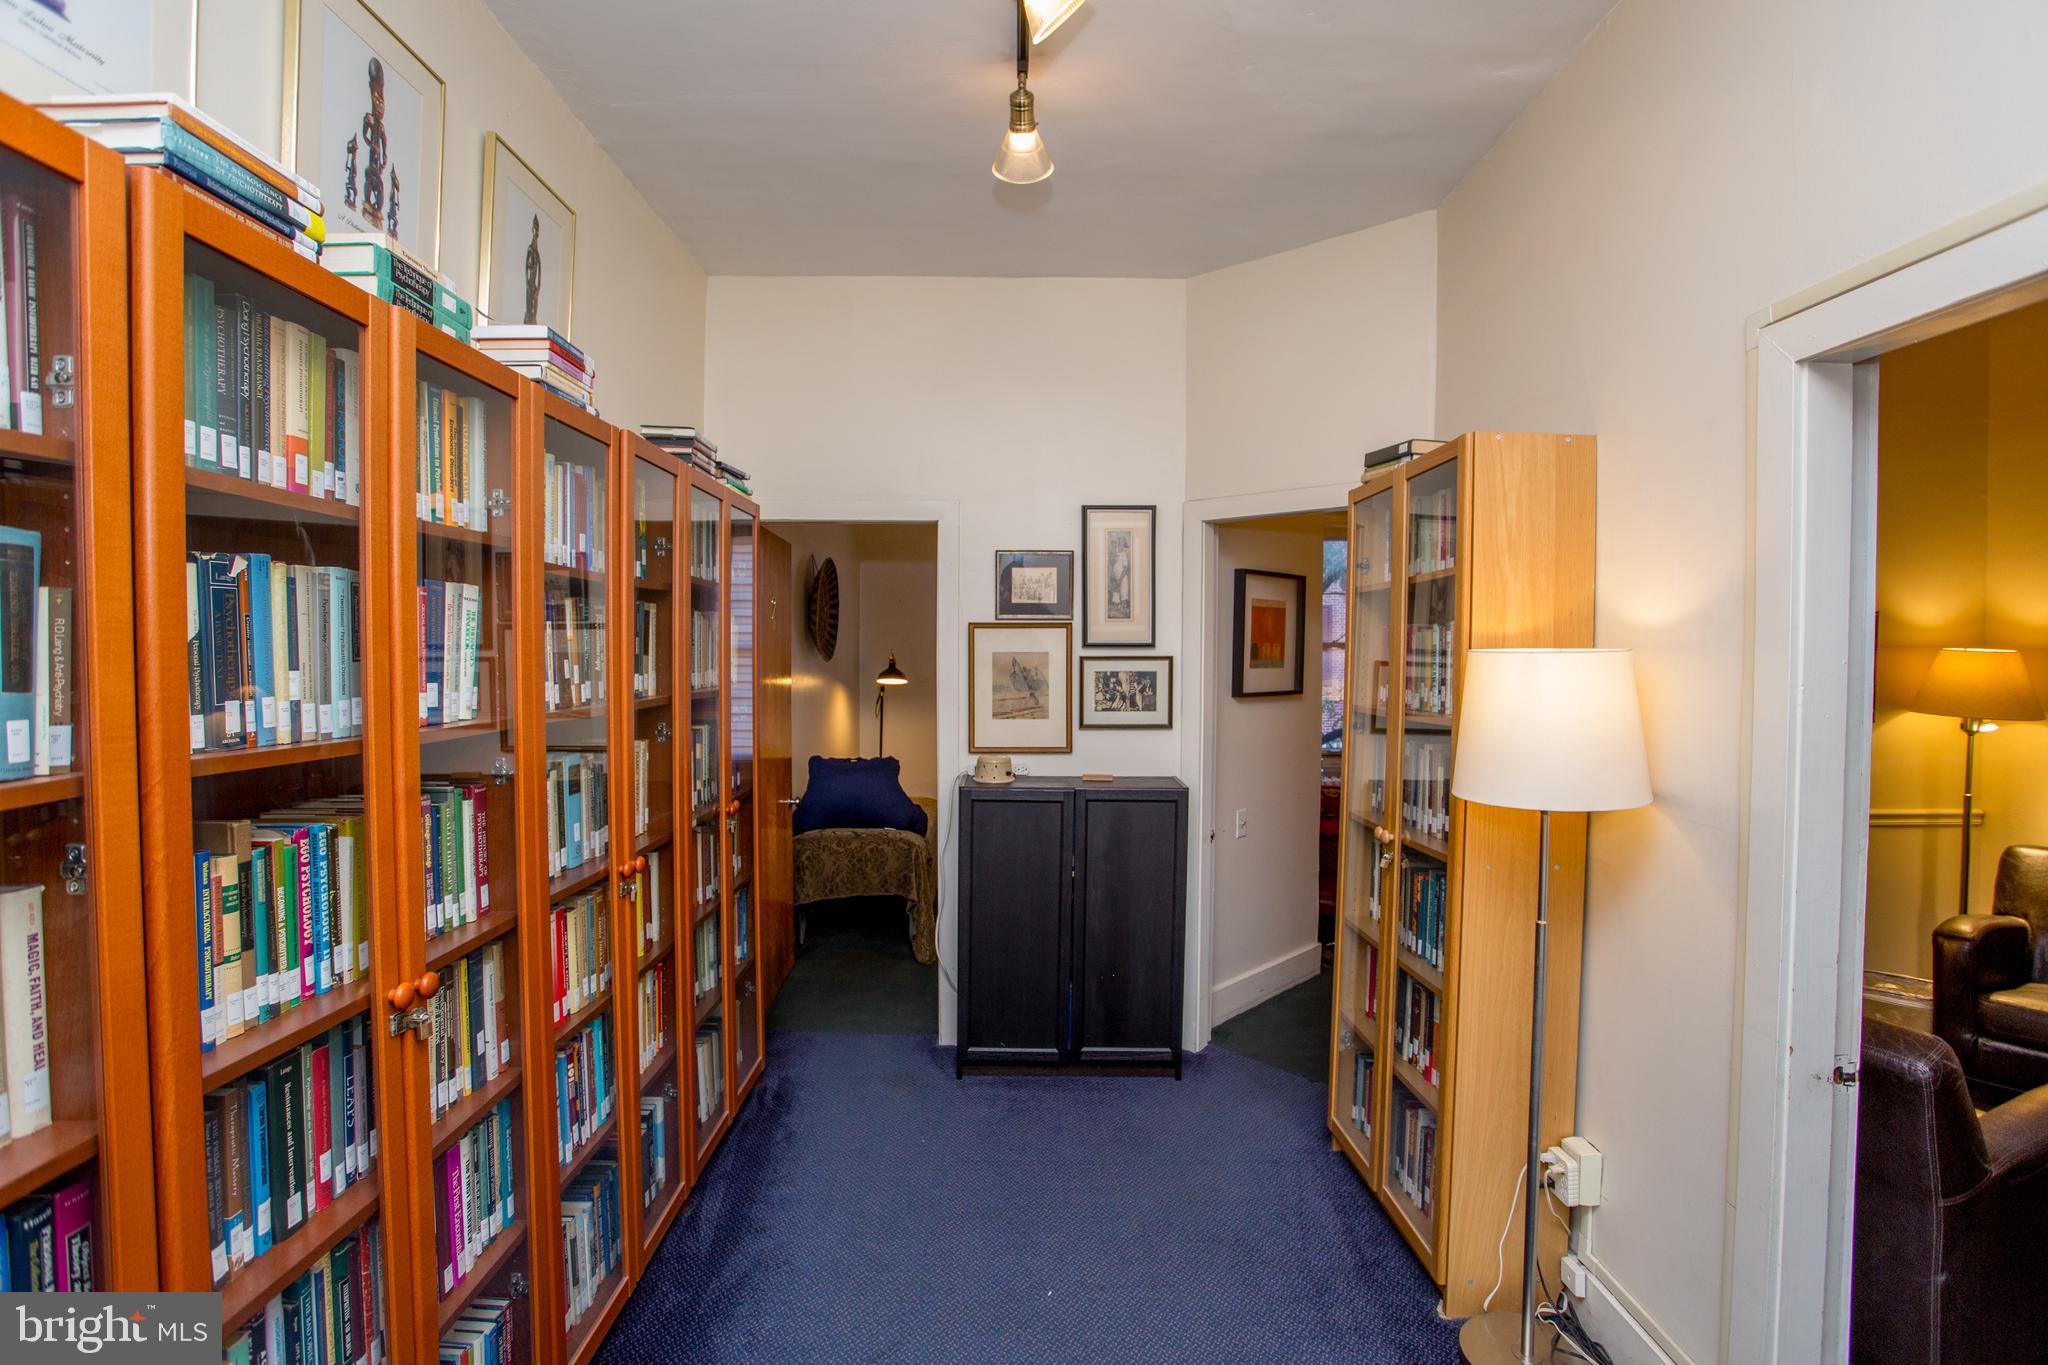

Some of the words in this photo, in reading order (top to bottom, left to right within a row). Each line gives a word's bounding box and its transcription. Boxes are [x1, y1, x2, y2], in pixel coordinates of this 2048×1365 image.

[215, 165, 225, 177] OF
[227, 172, 285, 212] PSYCHOTHERAPY
[231, 166, 284, 203] NEUROSCIENCE
[263, 209, 290, 236] Psychotherapy
[392, 258, 404, 271] The
[401, 262, 426, 287] Technique
[395, 268, 431, 299] Psychotherapy
[216, 306, 227, 396] PSYCHOTHERAPY
[240, 331, 251, 400] Psychotherapy
[215, 620, 223, 645] BASIC
[223, 592, 240, 697] Psychotherapy
[216, 654, 224, 679] TEXT
[193, 667, 203, 710] Psychotherapy
[300, 838, 310, 863] EGO
[311, 832, 319, 879] PSYCHOANALYTIC
[318, 830, 328, 856] EGO
[202, 887, 212, 944] INTERACTIONAL
[277, 886, 286, 920] BECOMING
[300, 865, 313, 946] PSYCHOLOGY
[319, 859, 330, 942] PSYCHOLOGY
[26, 932, 41, 976] MAGIC,
[314, 929, 322, 964] PSYCHOLOGY
[204, 945, 213, 1001] PSYCHOTHERAPY
[28, 976, 43, 1016] FAITH,
[31, 1016, 44, 1041] AND
[284, 1082, 293, 1131] Resistances
[229, 1104, 238, 1156] Therapeutic
[231, 1159, 240, 1197] Mastery
[453, 1187, 461, 1210] First
